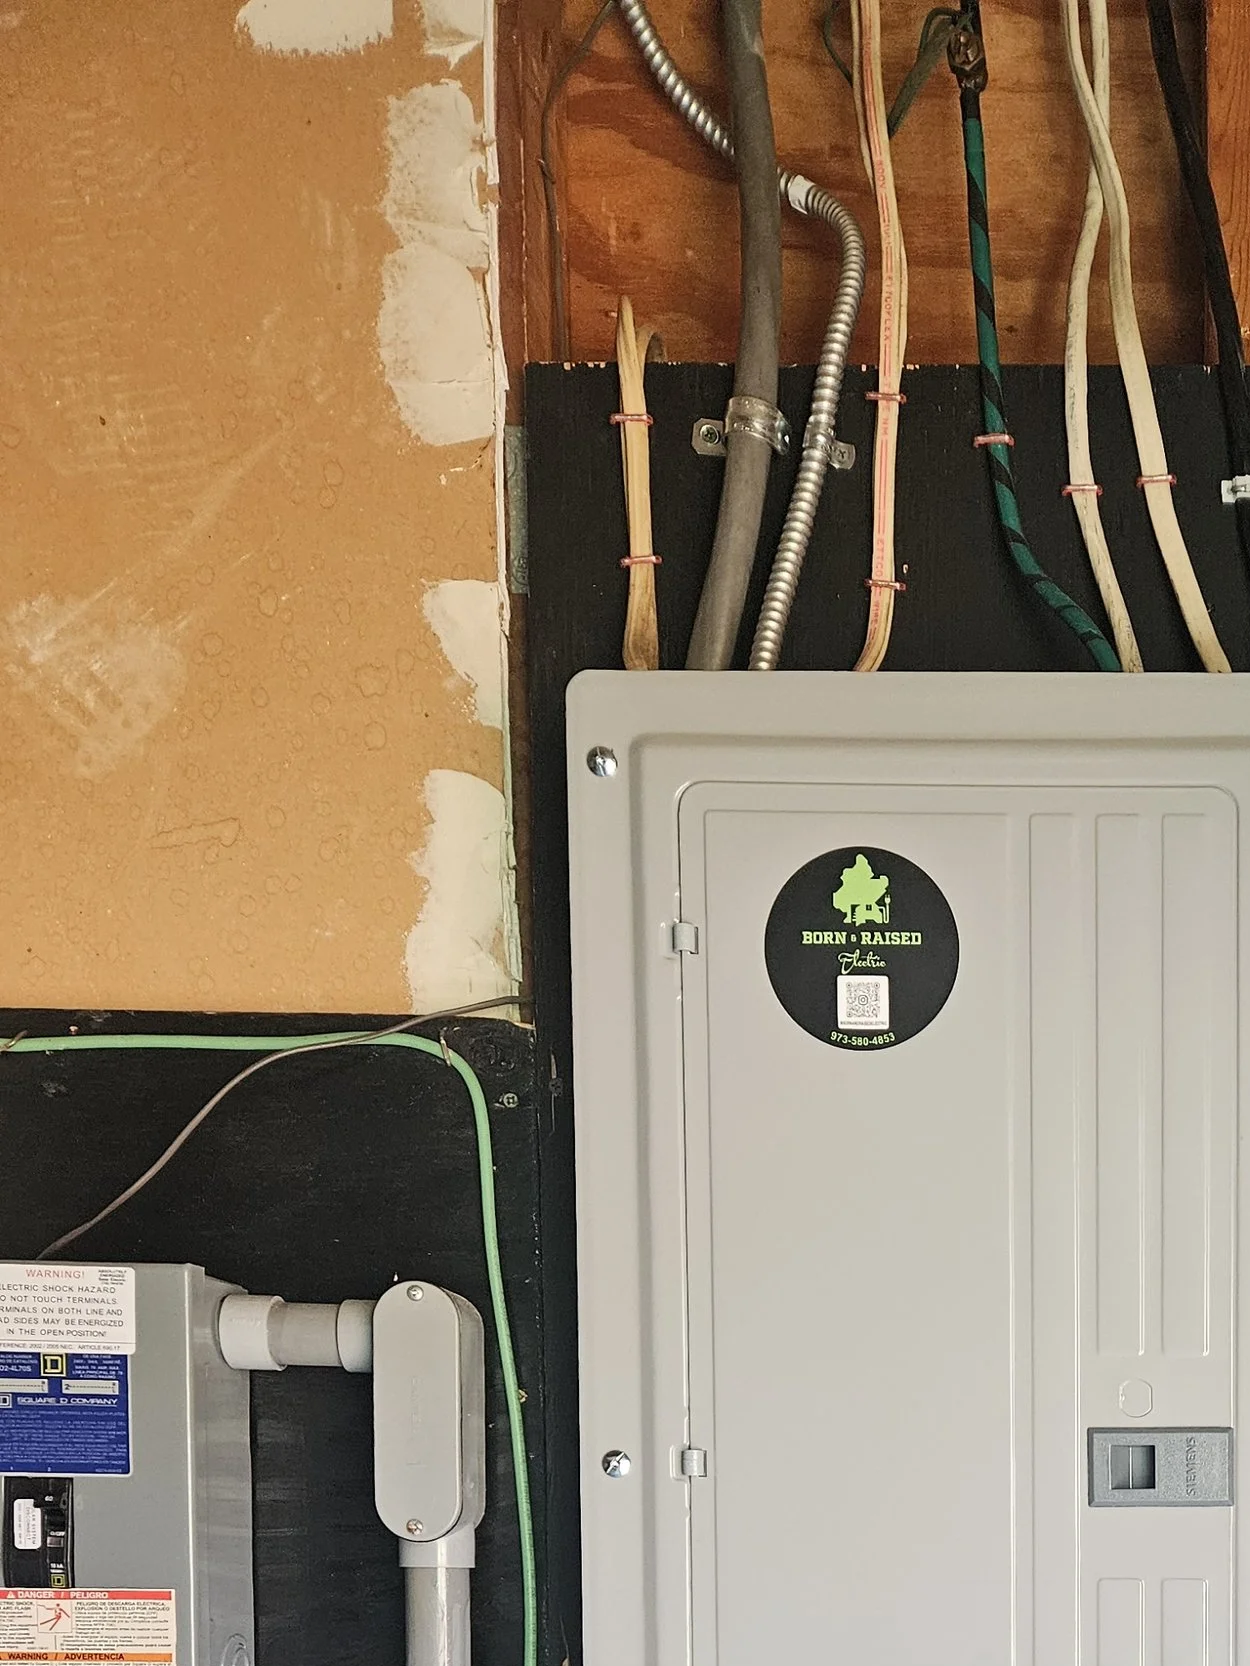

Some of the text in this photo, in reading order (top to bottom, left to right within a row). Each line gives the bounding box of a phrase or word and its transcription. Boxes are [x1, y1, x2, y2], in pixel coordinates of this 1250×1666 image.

[802, 931, 847, 945] BORN
[860, 931, 922, 945] RAISED
[837, 948, 887, 975] Electric
[830, 1030, 896, 1046] 973-580-4853
[25, 1269, 85, 1279] WARNING!
[0, 1284, 39, 1292] LECTRIC
[77, 1286, 116, 1294] HAZARD
[41, 1306, 54, 1314] ON
[58, 1307, 82, 1315] BOTH
[86, 1308, 104, 1316] LINE
[106, 1308, 123, 1316] AND
[42, 1317, 61, 1325] MAY
[64, 1318, 76, 1326] BE
[77, 1318, 124, 1327] ENERGIZED
[19, 1328, 36, 1336] THE
[40, 1328, 64, 1336] OPEN
[66, 1329, 107, 1337] POSITION!
[1185, 1436, 1197, 1497] SIEMENS
[64, 1653, 125, 1661] ADVERTENCIA
